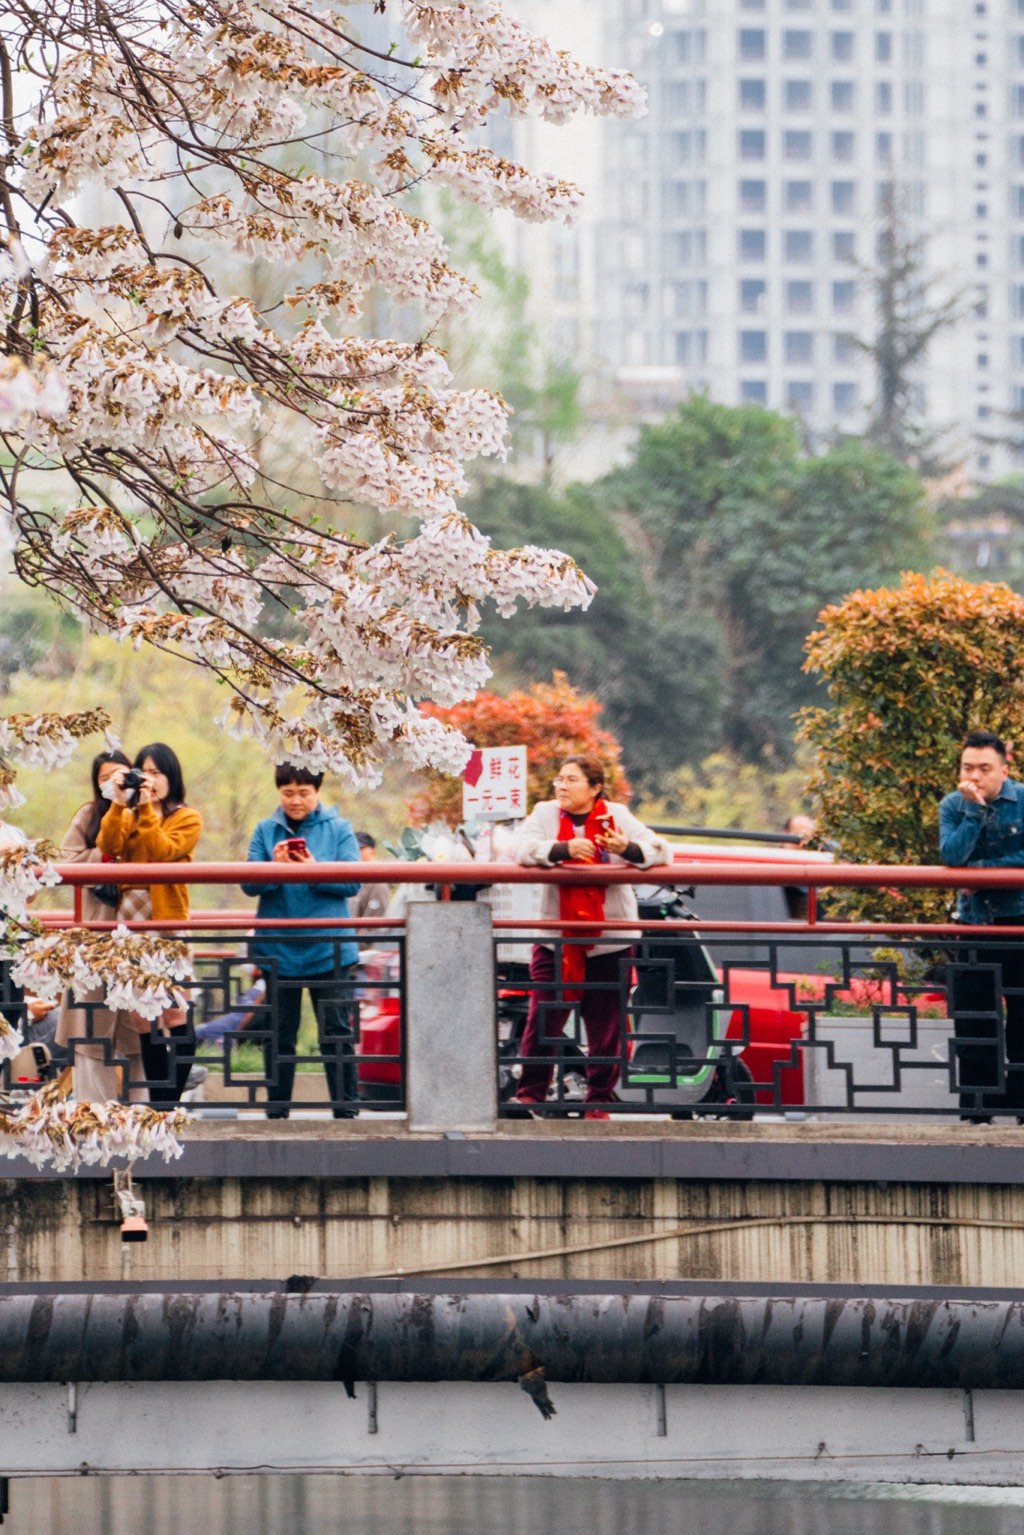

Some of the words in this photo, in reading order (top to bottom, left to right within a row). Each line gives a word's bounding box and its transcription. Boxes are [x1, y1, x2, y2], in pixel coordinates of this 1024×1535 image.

[490, 756, 520, 780] 鲜花
[467, 788, 521, 810] 一元一束
